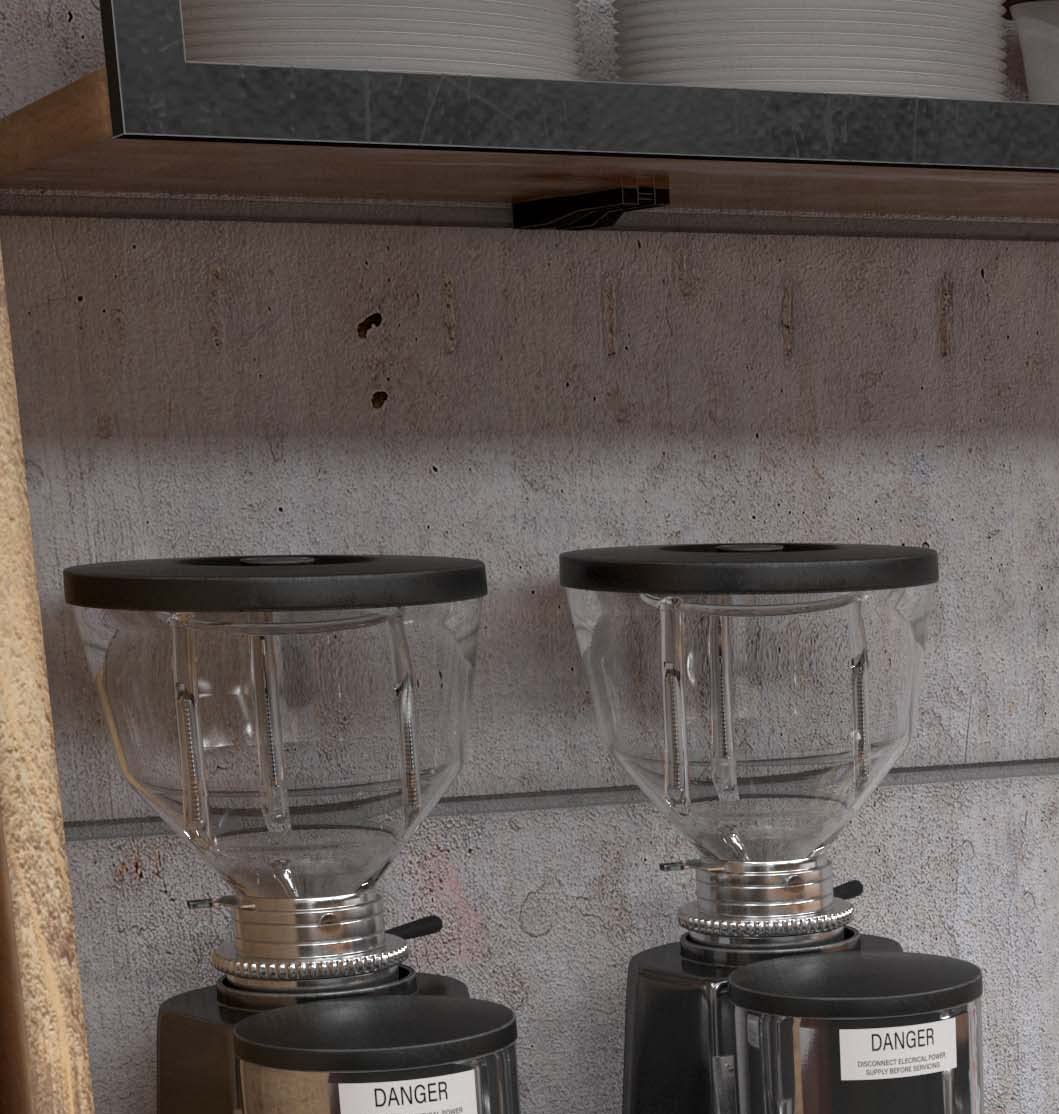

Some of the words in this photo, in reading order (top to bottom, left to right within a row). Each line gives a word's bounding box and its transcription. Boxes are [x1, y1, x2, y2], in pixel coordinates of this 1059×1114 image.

[871, 1028, 935, 1052] DANGER
[857, 1058, 897, 1068] DISCONNECT
[928, 1051, 946, 1060] POWER
[865, 1067, 888, 1076] SUPPLY
[889, 1065, 911, 1074] BEFORE
[912, 1061, 941, 1072] SERVICING
[374, 1081, 449, 1108] DANGER
